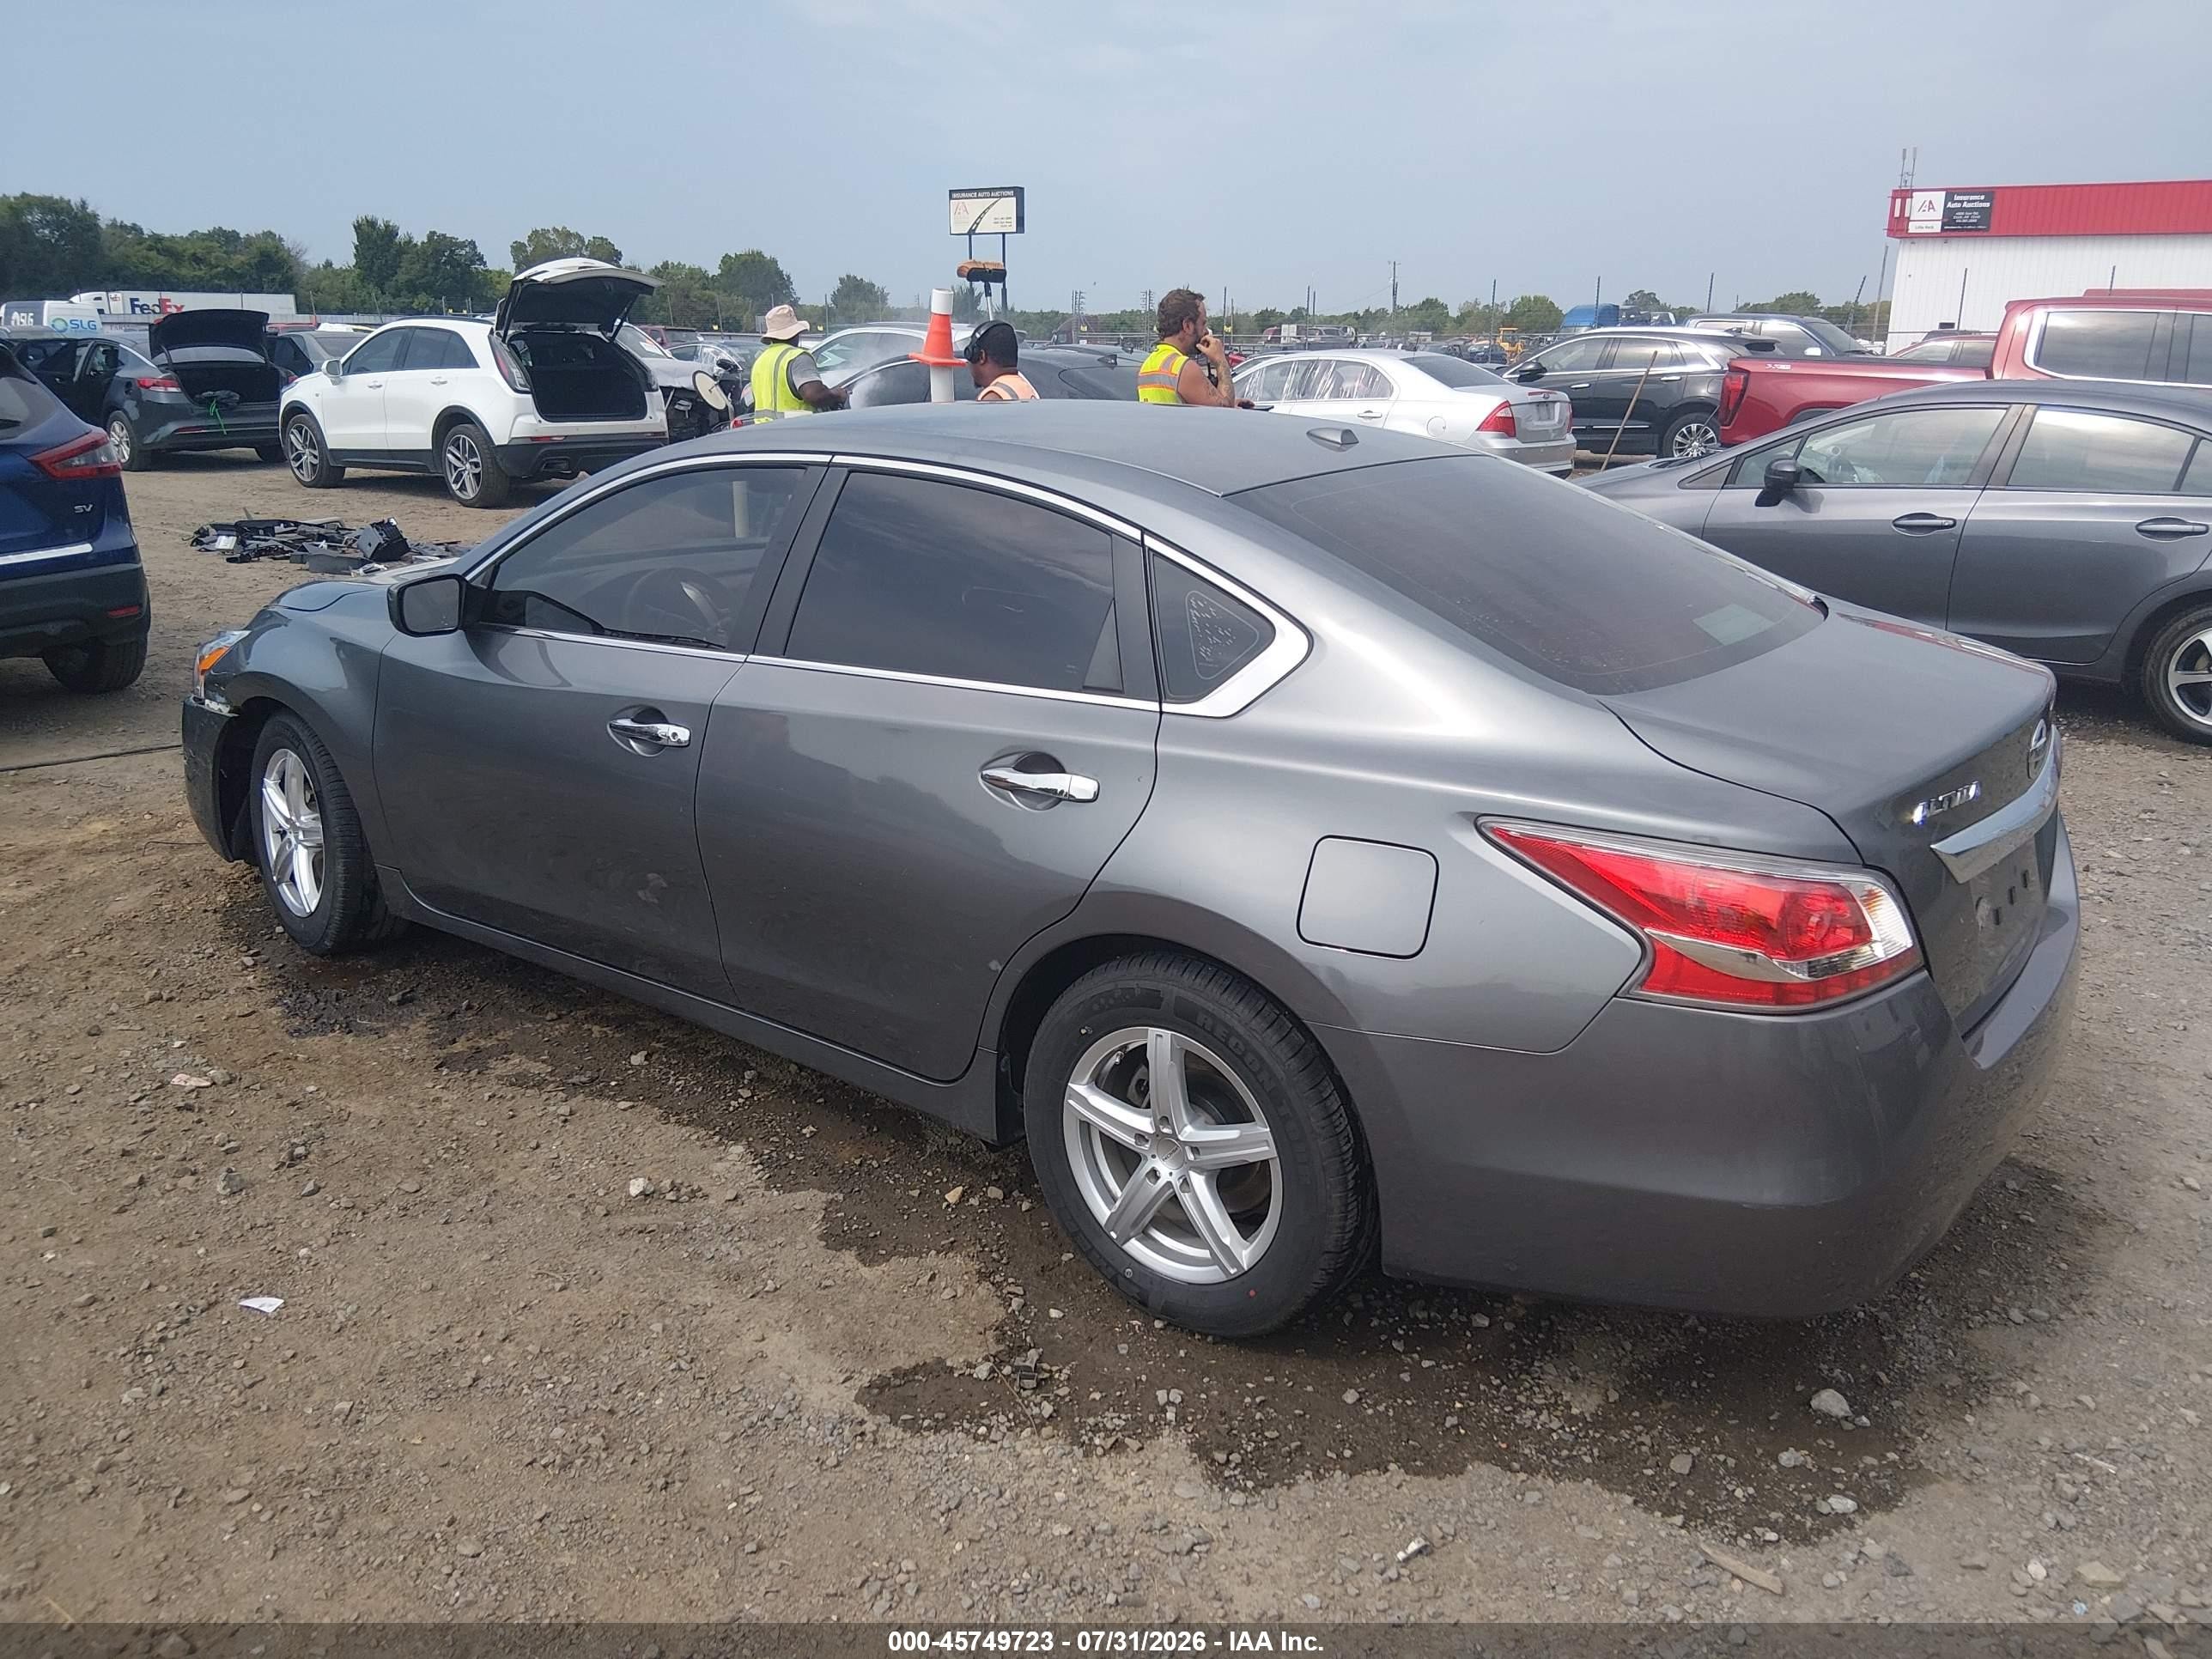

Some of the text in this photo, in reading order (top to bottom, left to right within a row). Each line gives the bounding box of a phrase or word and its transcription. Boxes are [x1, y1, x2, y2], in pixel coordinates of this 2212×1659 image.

[130, 297, 185, 315] FedEx
[69, 319, 97, 331] SLG
[74, 504, 94, 514] SV
